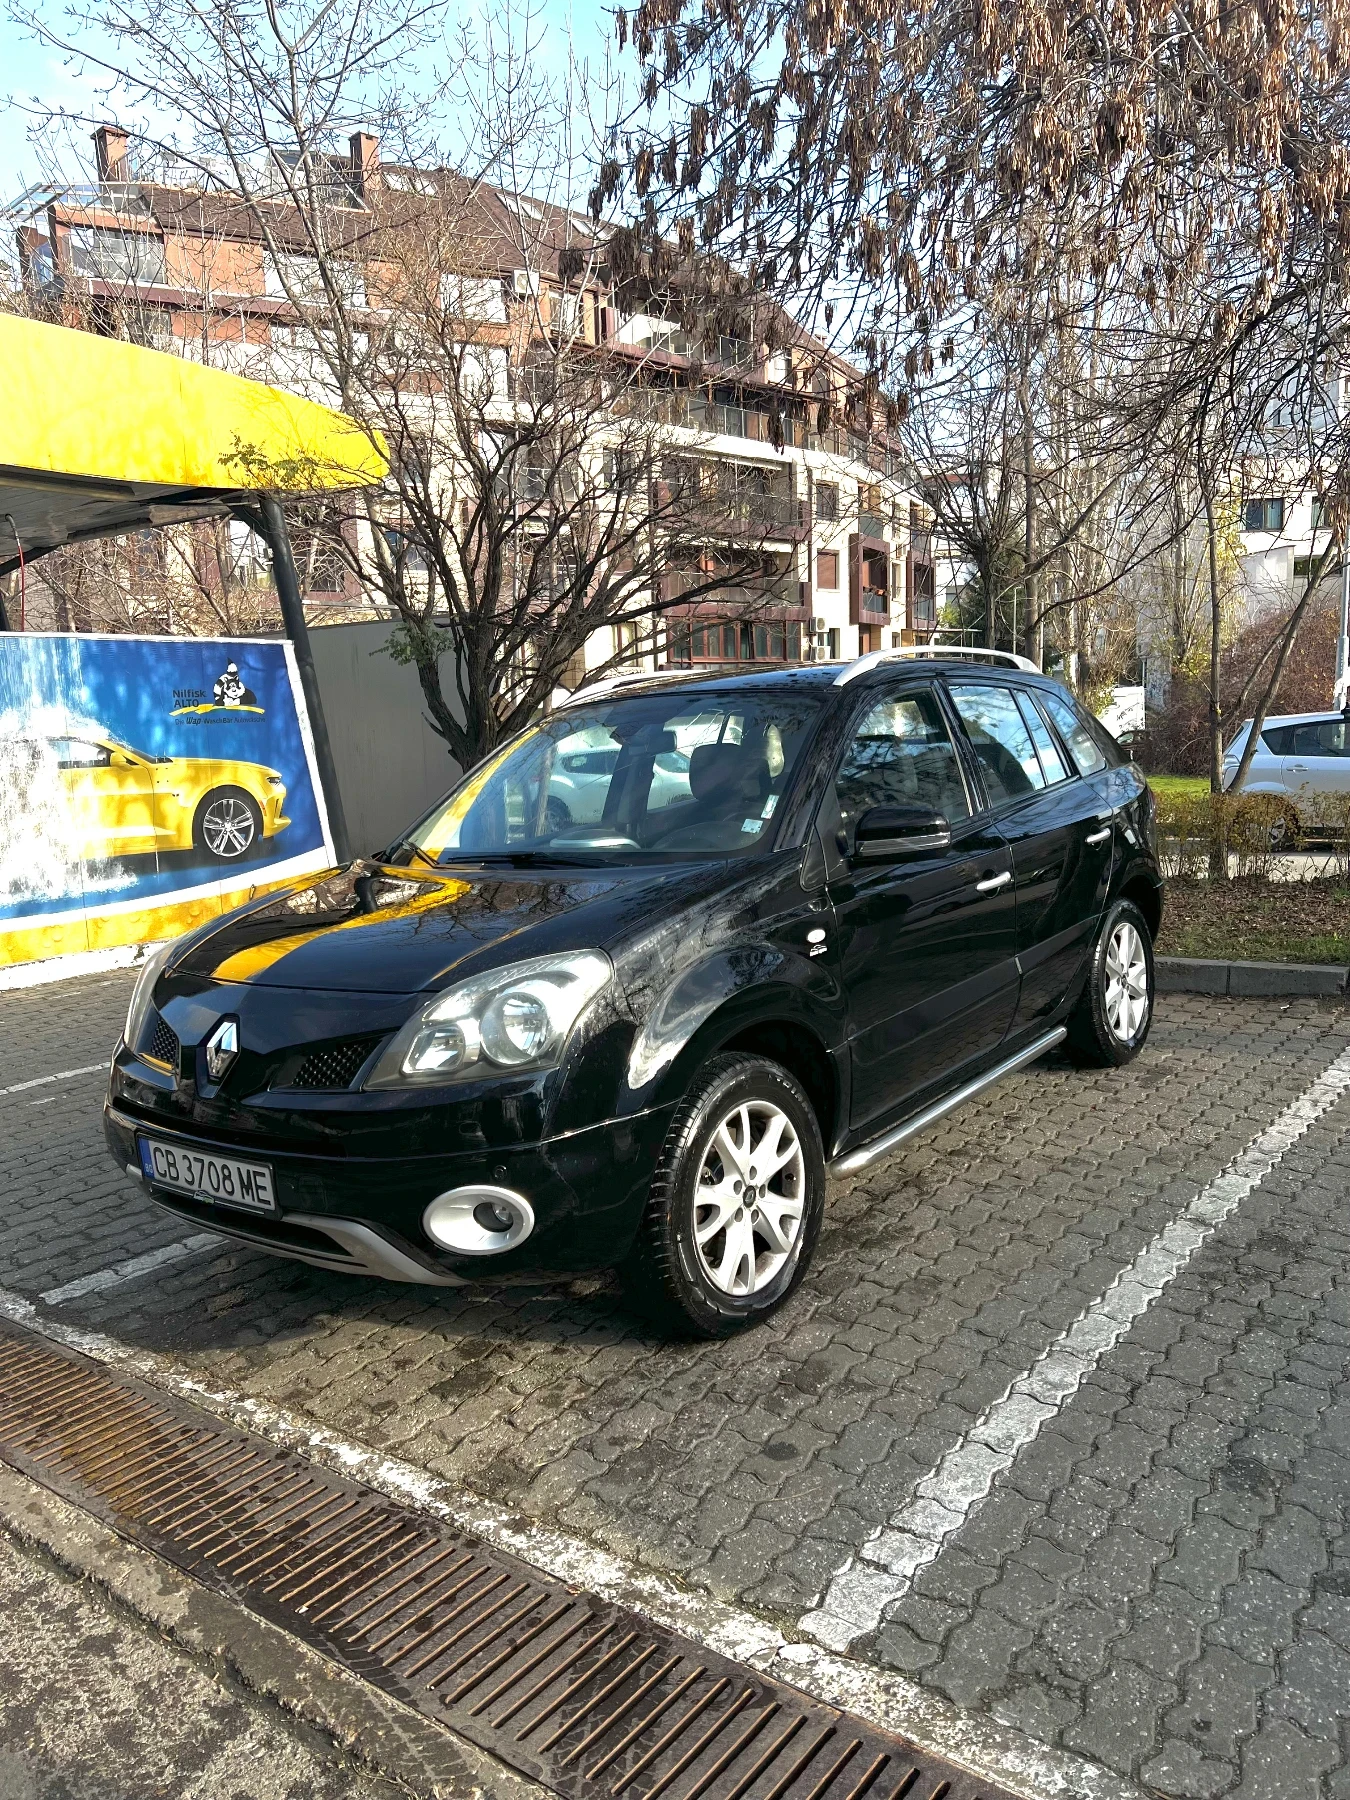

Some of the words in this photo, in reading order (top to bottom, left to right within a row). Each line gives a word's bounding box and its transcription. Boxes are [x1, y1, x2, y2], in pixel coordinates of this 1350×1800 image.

[172, 689, 207, 698] Nilfisk
[174, 699, 199, 708] ALTO
[144, 1162, 154, 1174] BG
[152, 1146, 180, 1182] CB
[181, 1154, 235, 1196] 3708
[236, 1166, 272, 1206] ME
